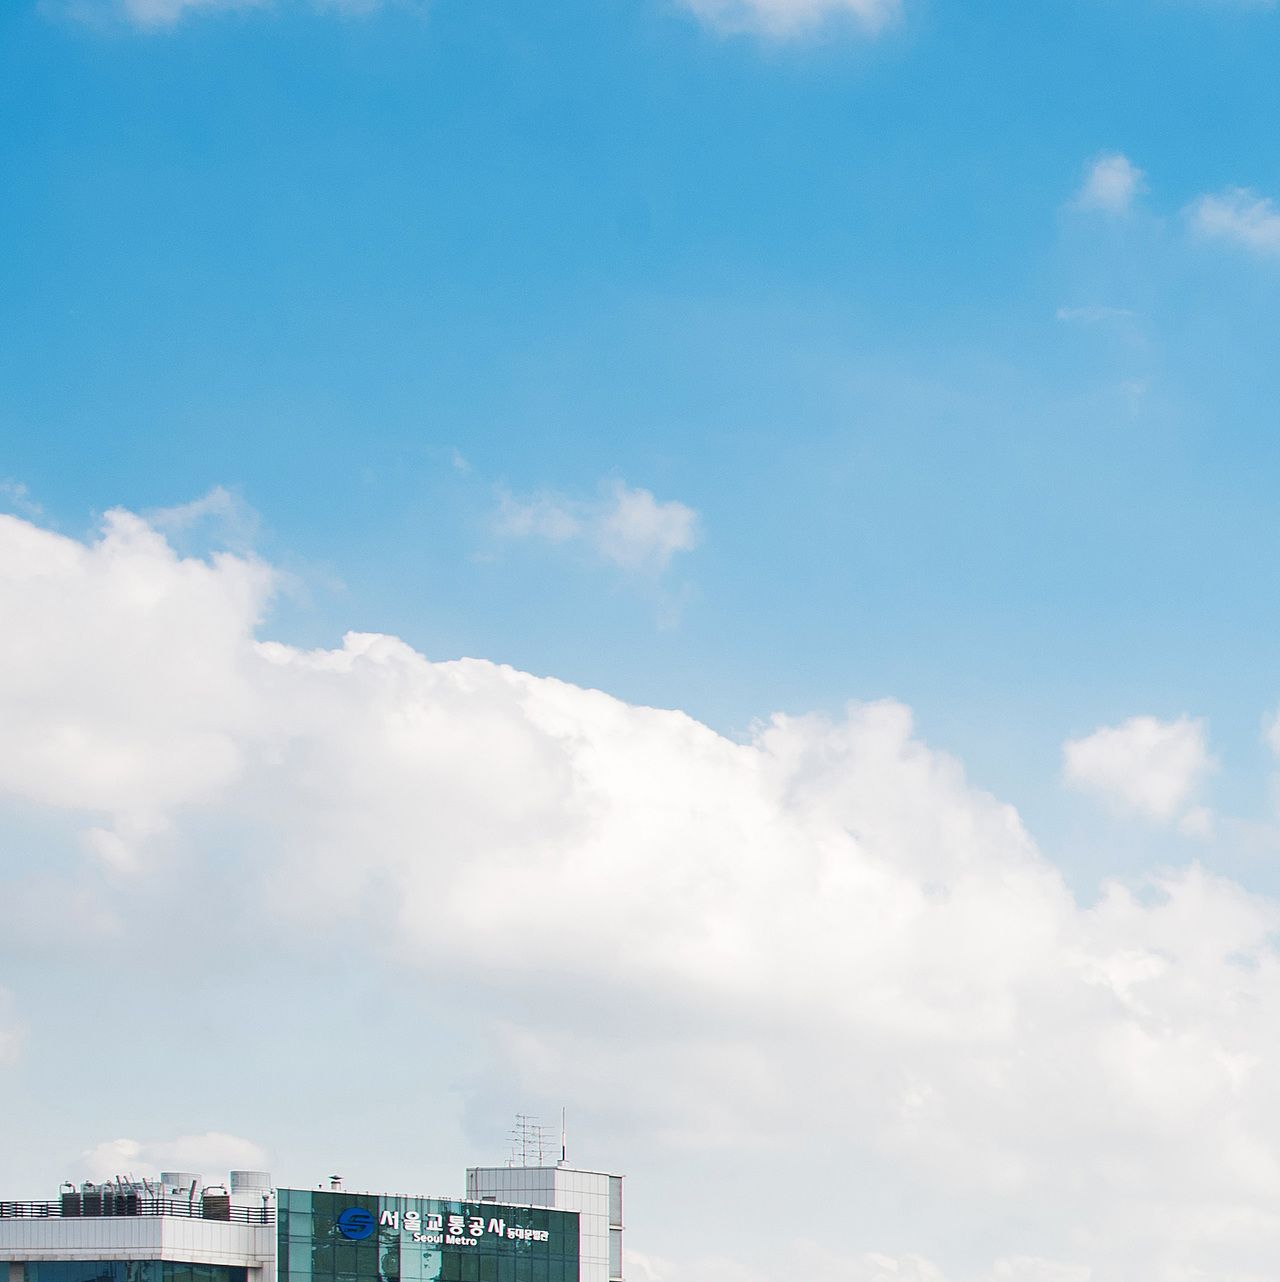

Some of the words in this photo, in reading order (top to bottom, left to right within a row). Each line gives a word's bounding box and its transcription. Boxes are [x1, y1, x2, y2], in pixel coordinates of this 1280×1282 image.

[379, 1210, 506, 1237] 서울교통공사
[413, 1231, 443, 1244] Seoul
[445, 1234, 478, 1246] Metro
